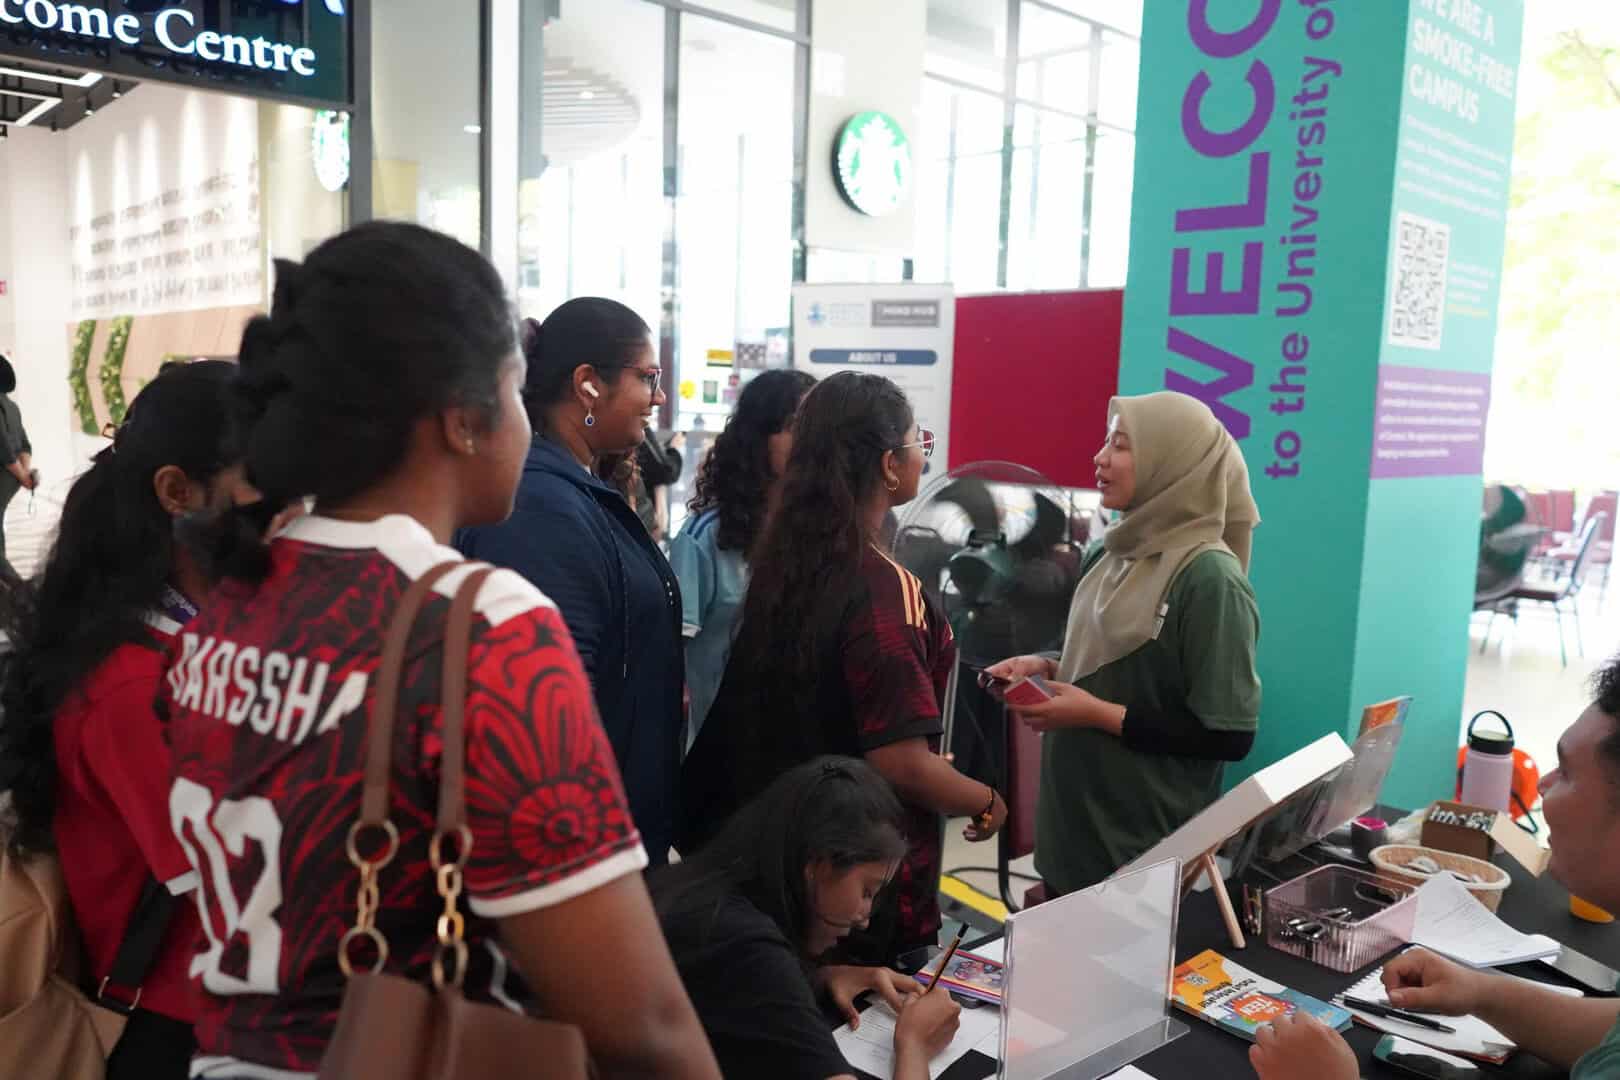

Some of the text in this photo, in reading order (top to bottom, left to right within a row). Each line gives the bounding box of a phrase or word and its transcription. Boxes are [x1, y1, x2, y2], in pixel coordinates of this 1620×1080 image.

[154, 8, 315, 76] Centre
[1413, 18, 1513, 99] SMOKE-FREE
[1483, 14, 1496, 46] A
[1408, 63, 1480, 124] CAMPUS
[1275, 57, 1343, 318] University
[848, 351, 897, 364] ABOUT US
[1269, 332, 1310, 416] the
[1264, 430, 1302, 479] to
